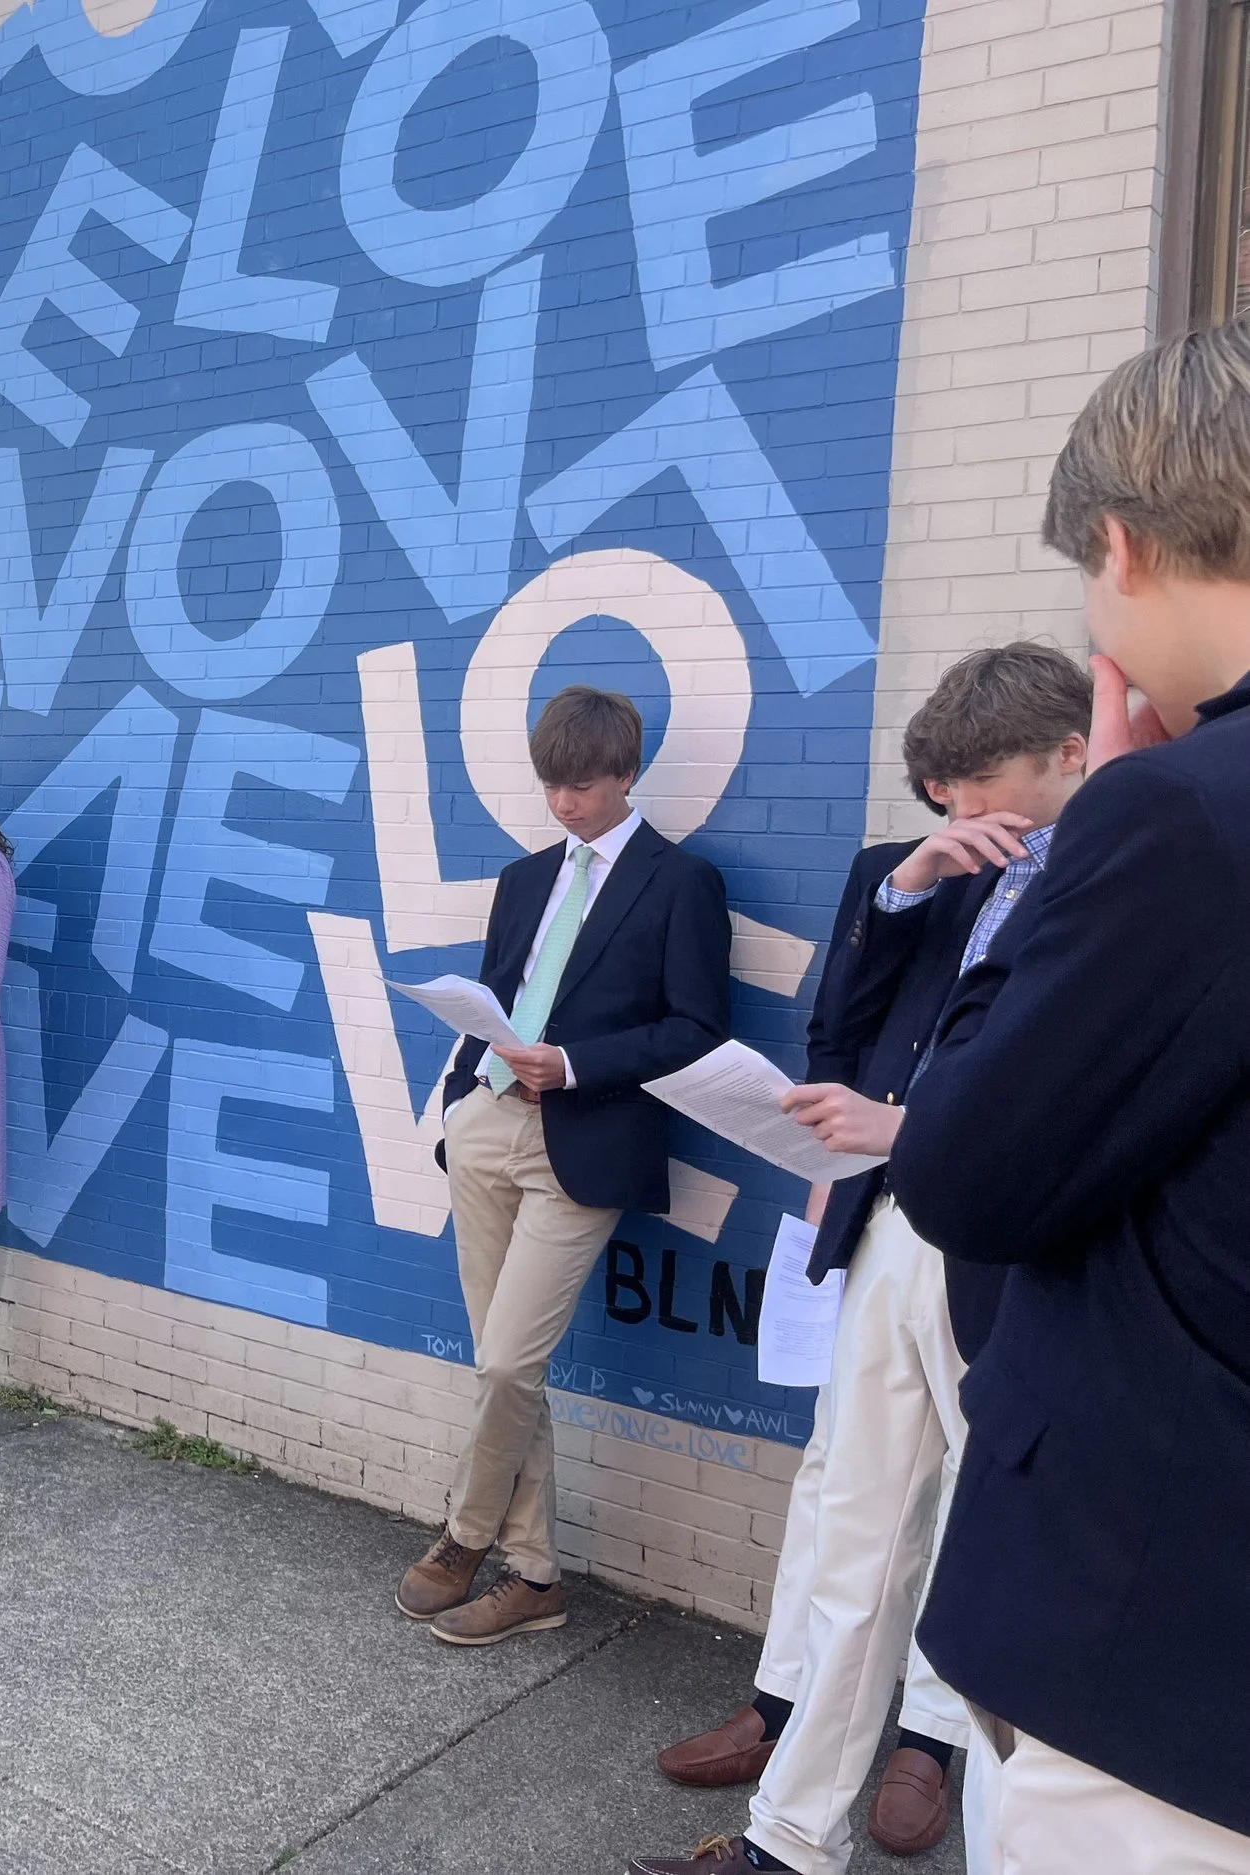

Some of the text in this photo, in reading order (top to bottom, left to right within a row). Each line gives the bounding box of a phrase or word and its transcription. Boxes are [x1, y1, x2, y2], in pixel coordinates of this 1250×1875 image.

[419, 1333, 463, 1360] TOM
[550, 1361, 588, 1393] RYL
[659, 1392, 722, 1425] SUNNY
